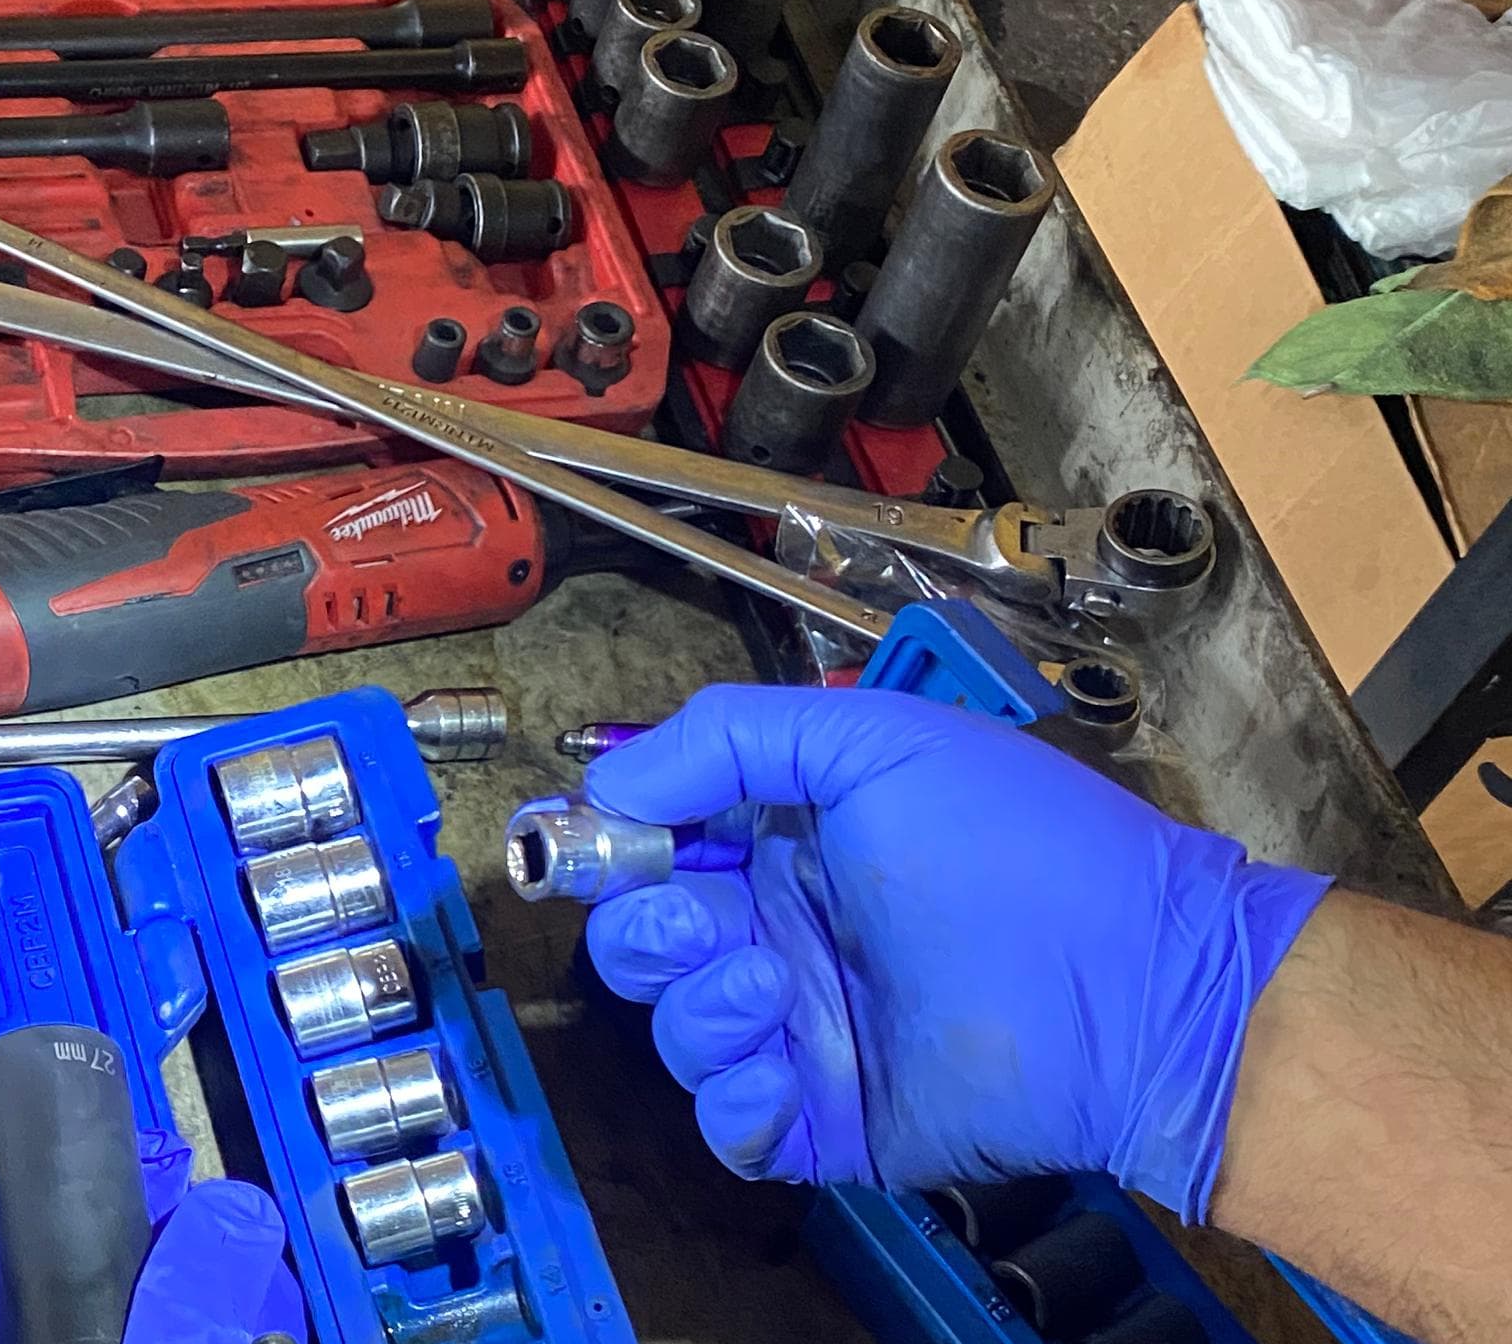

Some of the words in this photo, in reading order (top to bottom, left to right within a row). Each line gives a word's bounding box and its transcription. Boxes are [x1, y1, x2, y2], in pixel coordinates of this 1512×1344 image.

[329, 491, 443, 542] Milwaukee
[870, 501, 905, 527] 19
[53, 1041, 87, 1062] mm
[90, 1047, 116, 1076] 27
